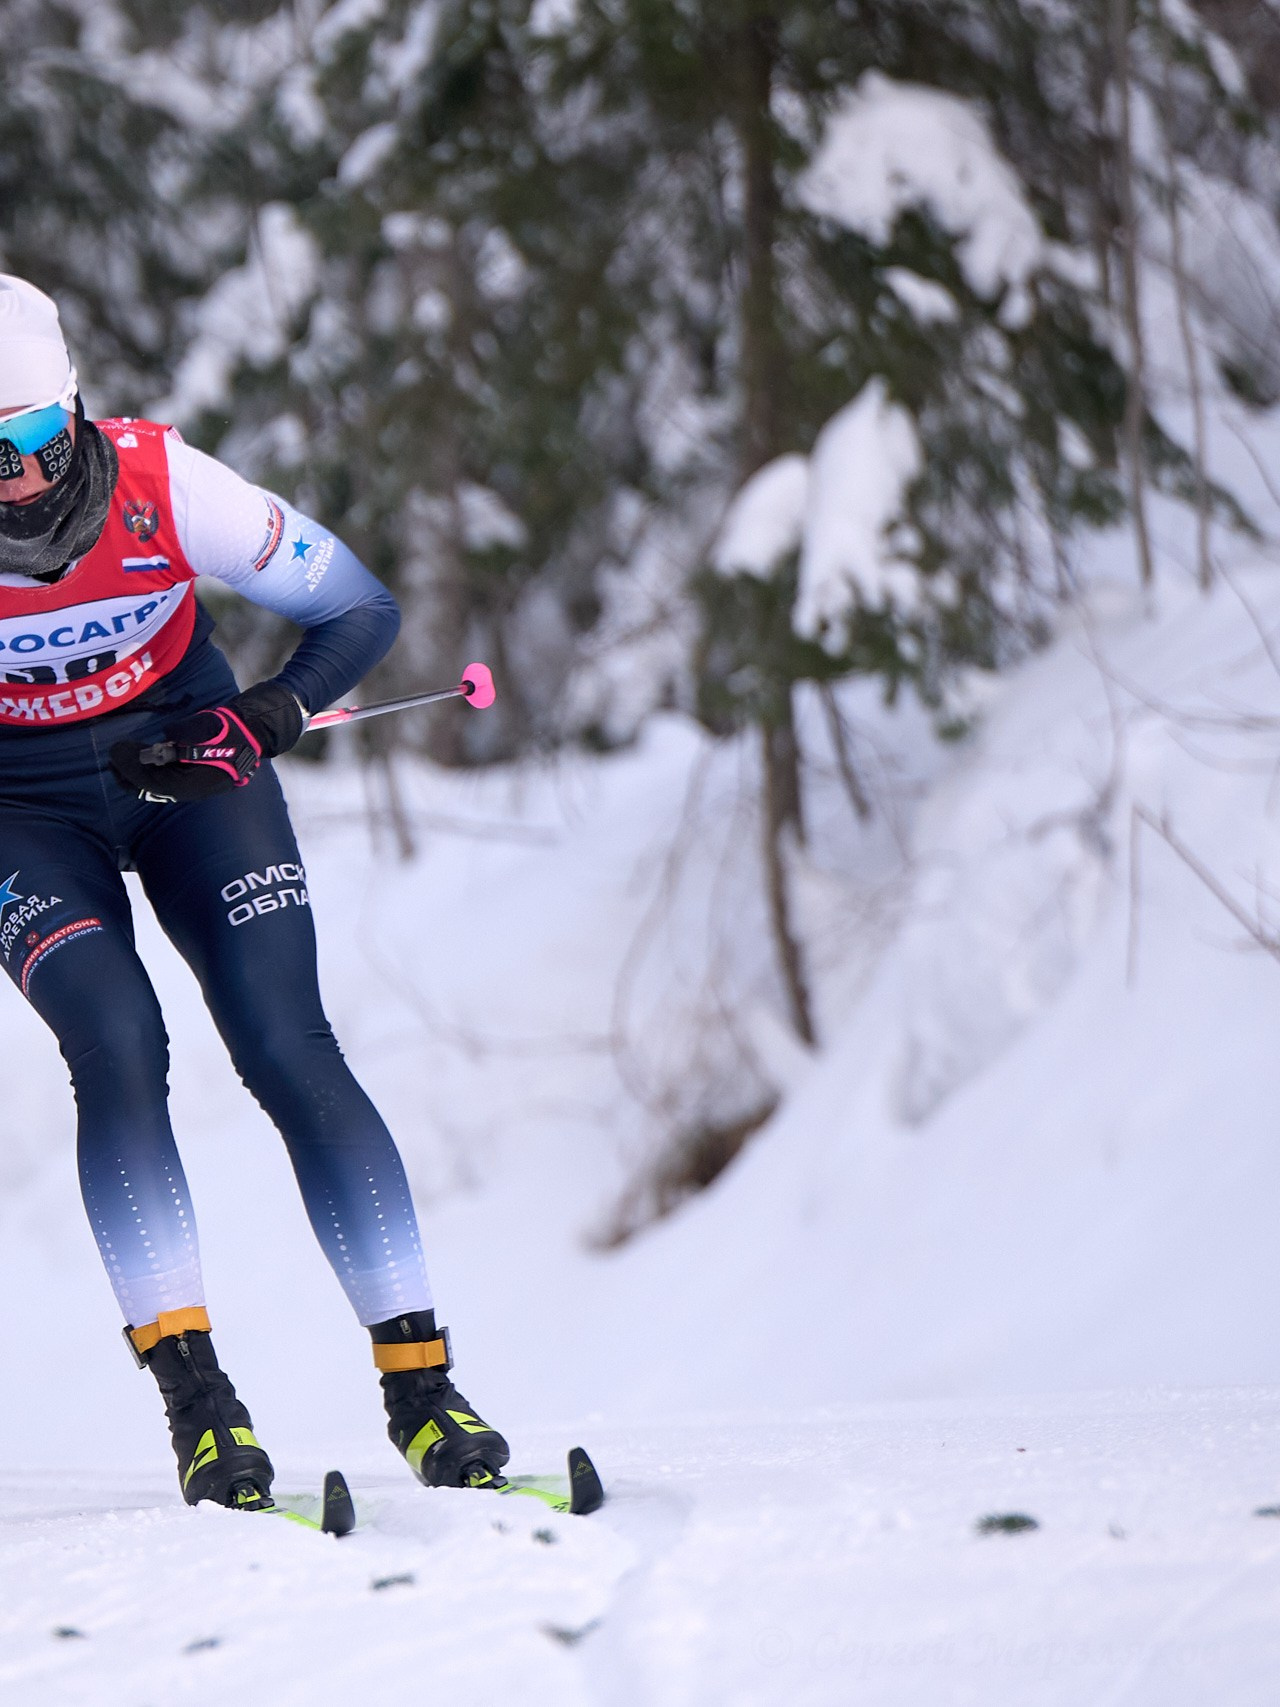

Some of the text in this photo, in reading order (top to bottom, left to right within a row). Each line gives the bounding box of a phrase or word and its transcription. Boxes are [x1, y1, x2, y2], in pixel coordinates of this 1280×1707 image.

[304, 540, 327, 580] НОВАЯ
[307, 537, 335, 593] АТЛЕТИКА
[0, 895, 40, 945] НОВАЯ
[4, 896, 63, 962] АТЛЕТИКА
[40, 919, 98, 949] БИАТЛОНА
